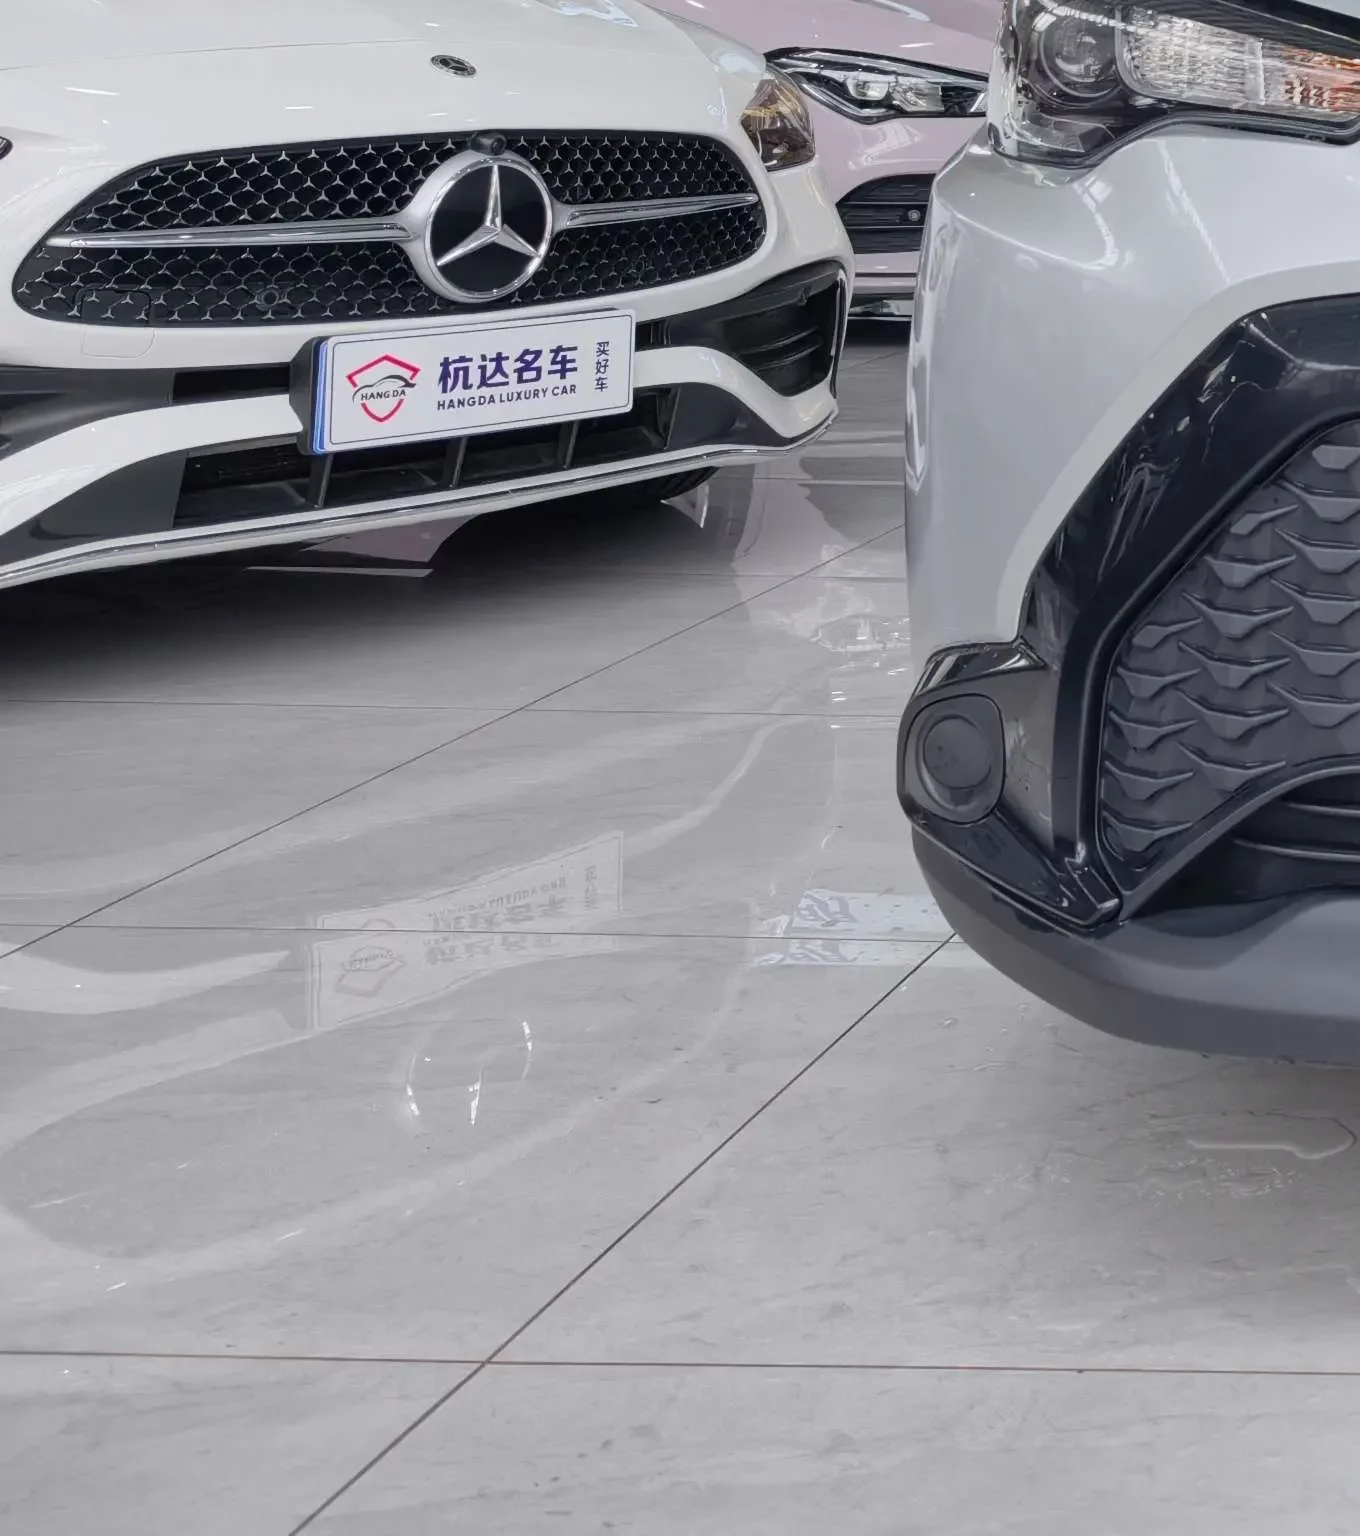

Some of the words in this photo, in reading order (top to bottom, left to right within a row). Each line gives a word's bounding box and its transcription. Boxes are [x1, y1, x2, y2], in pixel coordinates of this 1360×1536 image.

[437, 344, 579, 394] 杭达名车
[595, 340, 610, 392] 买好车
[361, 390, 391, 402] HANG
[392, 388, 407, 399] DA
[437, 395, 496, 412] HANGDA
[499, 386, 548, 404] LUXURY
[552, 383, 578, 397] CAR
